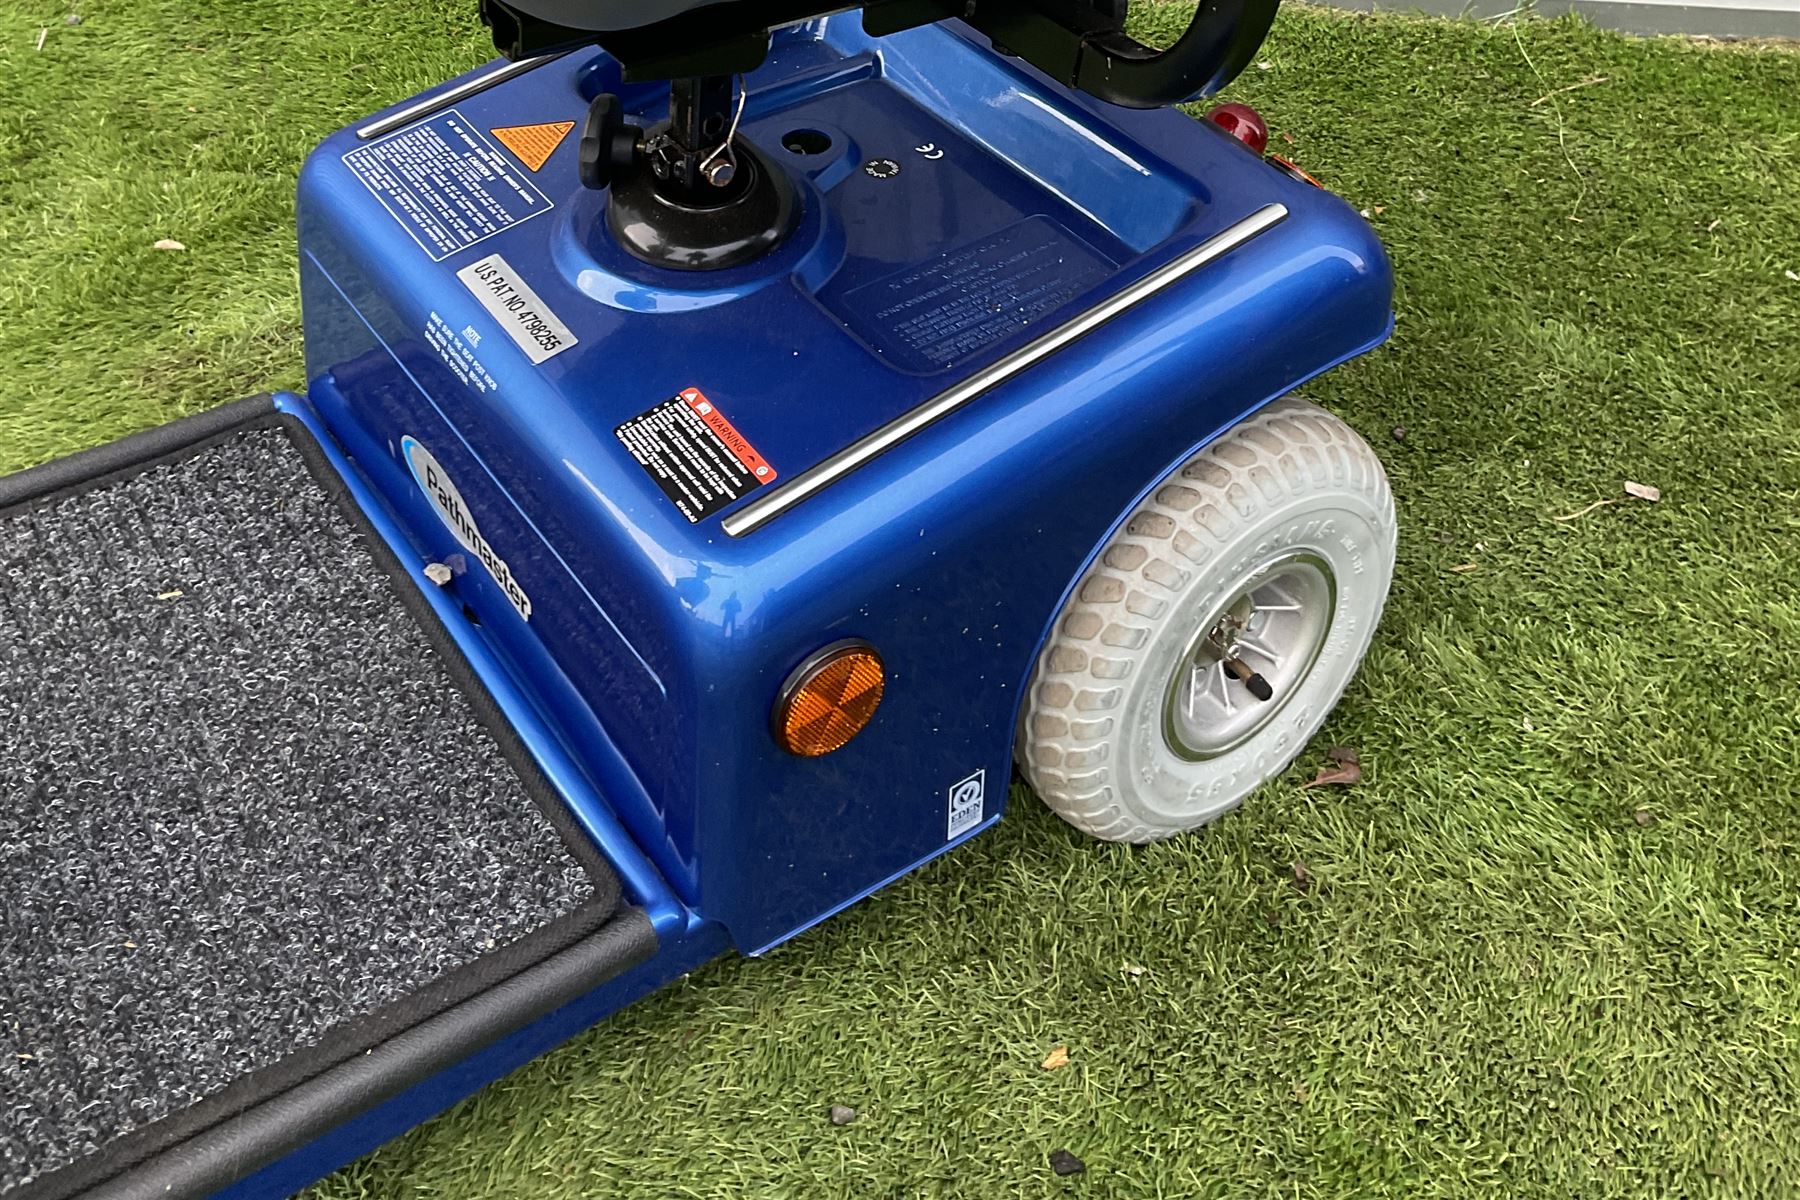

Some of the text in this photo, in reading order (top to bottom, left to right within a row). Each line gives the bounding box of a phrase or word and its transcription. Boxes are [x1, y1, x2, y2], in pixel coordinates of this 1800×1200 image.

[518, 311, 562, 351] 4798255
[711, 416, 746, 452] WARNING
[427, 466, 528, 612] Pathmaster
